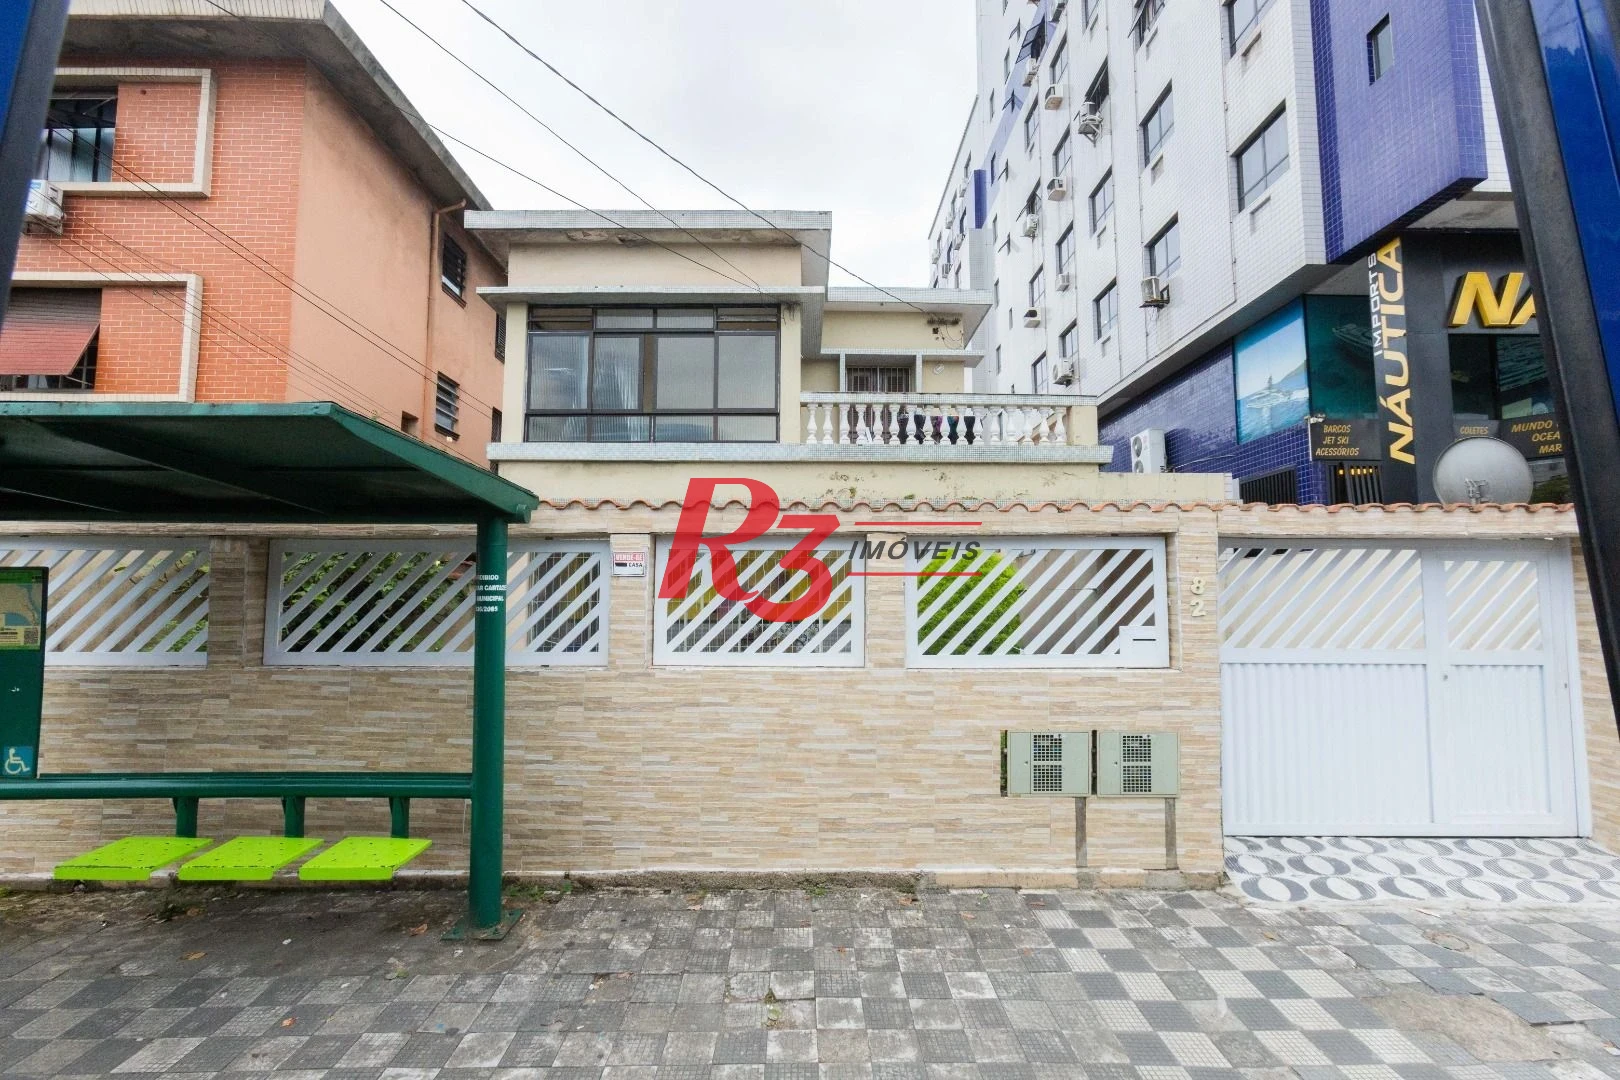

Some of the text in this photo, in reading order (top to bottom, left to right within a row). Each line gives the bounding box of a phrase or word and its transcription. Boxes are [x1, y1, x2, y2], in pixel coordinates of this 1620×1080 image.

[1367, 252, 1382, 357] IMPORTS
[1376, 236, 1415, 464] NÁUTICA
[1323, 424, 1352, 433] BARCOS
[1460, 426, 1489, 435] COLETES
[1511, 420, 1553, 433] MUNDO
[1322, 436, 1349, 445] JET SKI
[1532, 431, 1561, 442] OCEA
[1315, 446, 1360, 456] ACESSÓRIOS
